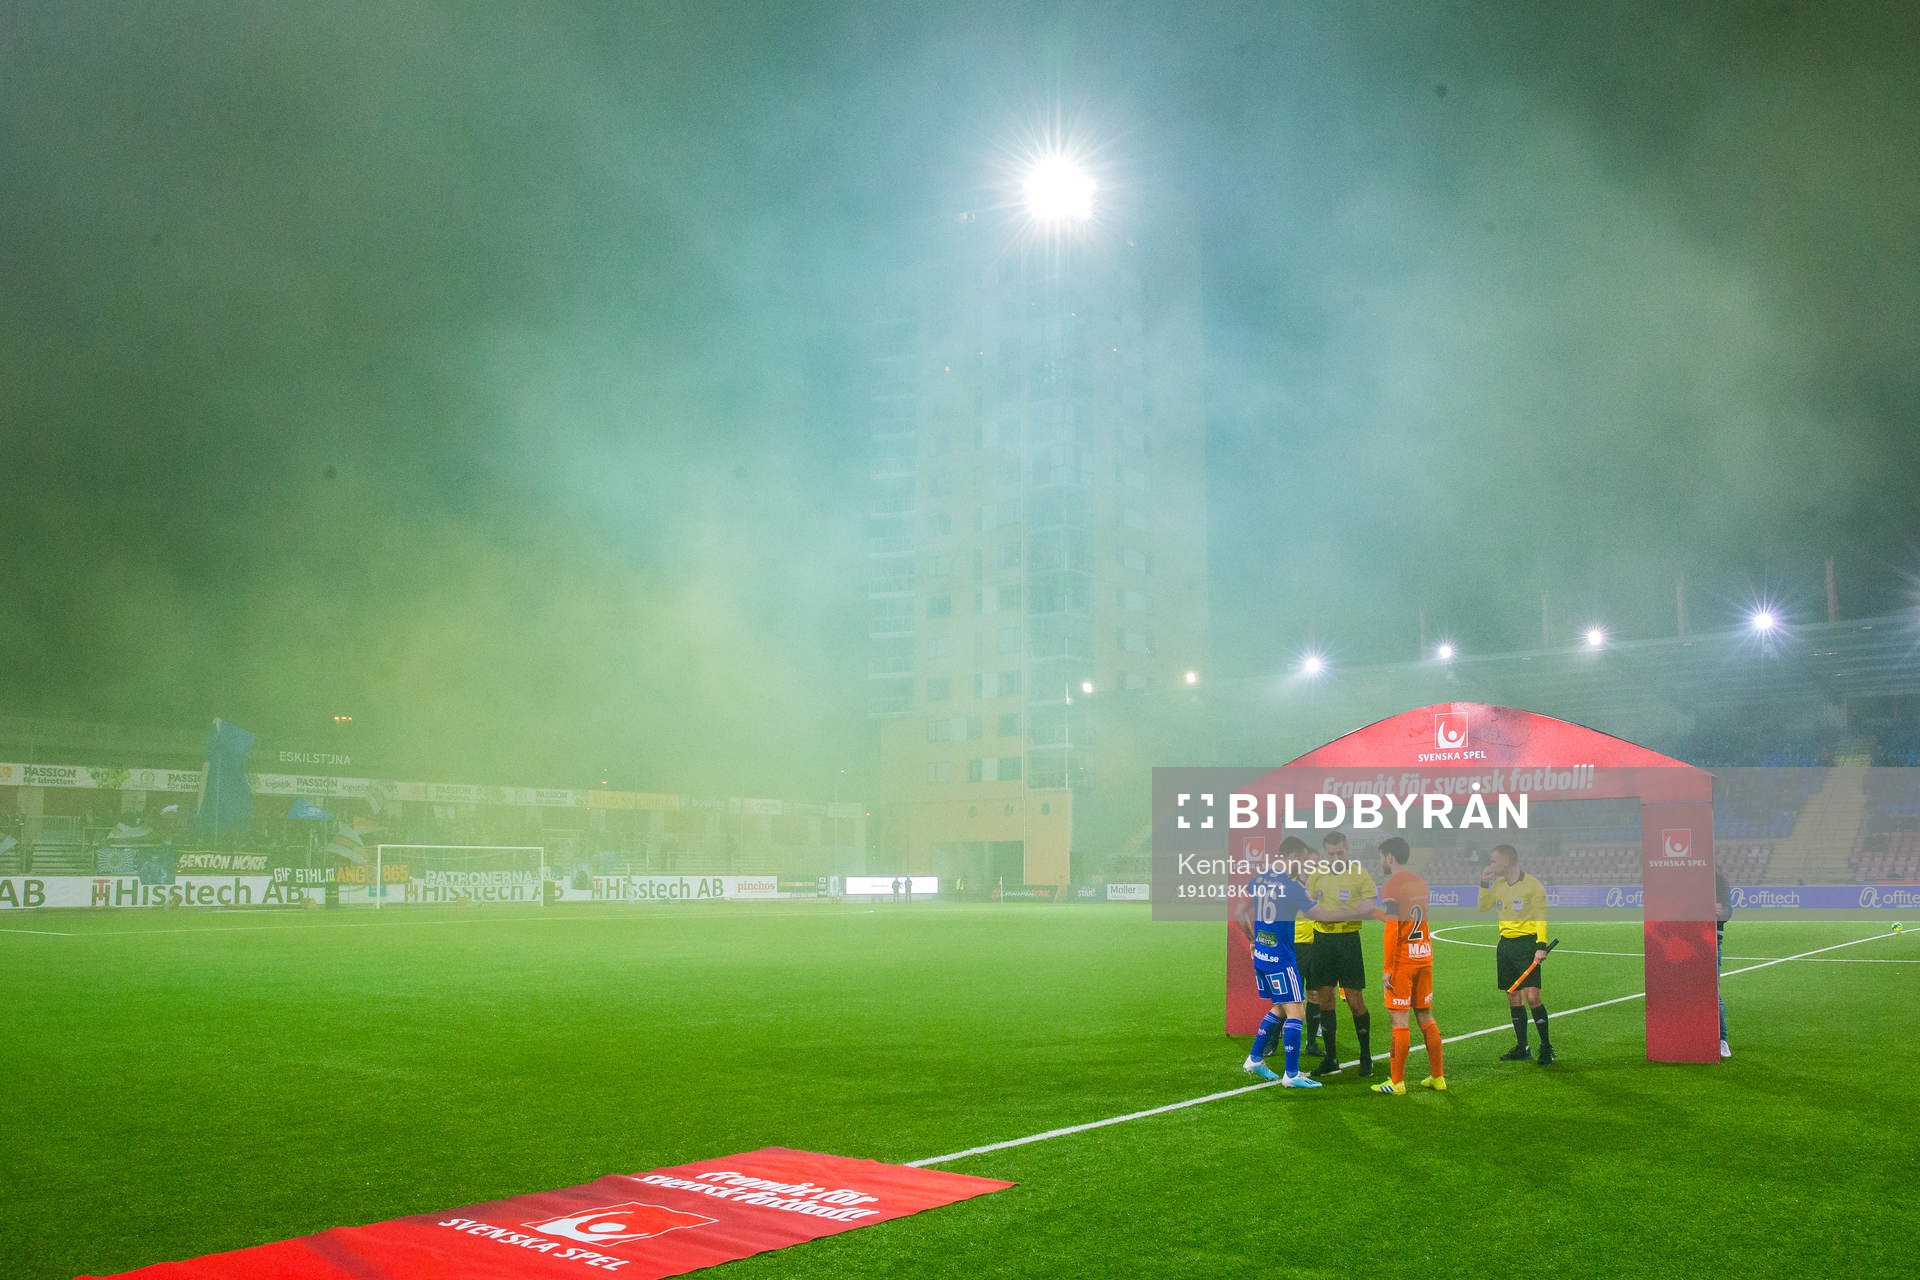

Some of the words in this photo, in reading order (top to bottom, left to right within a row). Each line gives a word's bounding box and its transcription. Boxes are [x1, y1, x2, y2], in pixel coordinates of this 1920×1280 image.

[279, 751, 351, 764] ESKILSTUNA
[1418, 752, 1460, 762] SVENSKA
[1463, 750, 1487, 760] SPEL
[24, 767, 77, 778] PASSION
[1322, 774, 1395, 799] Framåt
[1398, 772, 1431, 796] för
[1433, 770, 1505, 795] svensk
[1509, 764, 1595, 791] fotboll!
[178, 855, 231, 870] SEKTION
[274, 868, 292, 883] GIF
[424, 869, 532, 886] PATRONERNA
[0, 880, 46, 907] AB
[116, 878, 251, 906] Hisstech
[697, 878, 724, 898] AB
[737, 881, 776, 893] pinchos
[1257, 889, 1277, 924] 16
[1749, 891, 1800, 904] offitech
[1408, 905, 1423, 940] 2
[632, 1175, 746, 1198] svensk
[696, 1171, 825, 1197] Framåt
[808, 1188, 879, 1206] för
[438, 1218, 560, 1253] SVENSKA
[553, 1248, 630, 1271] SPEL
